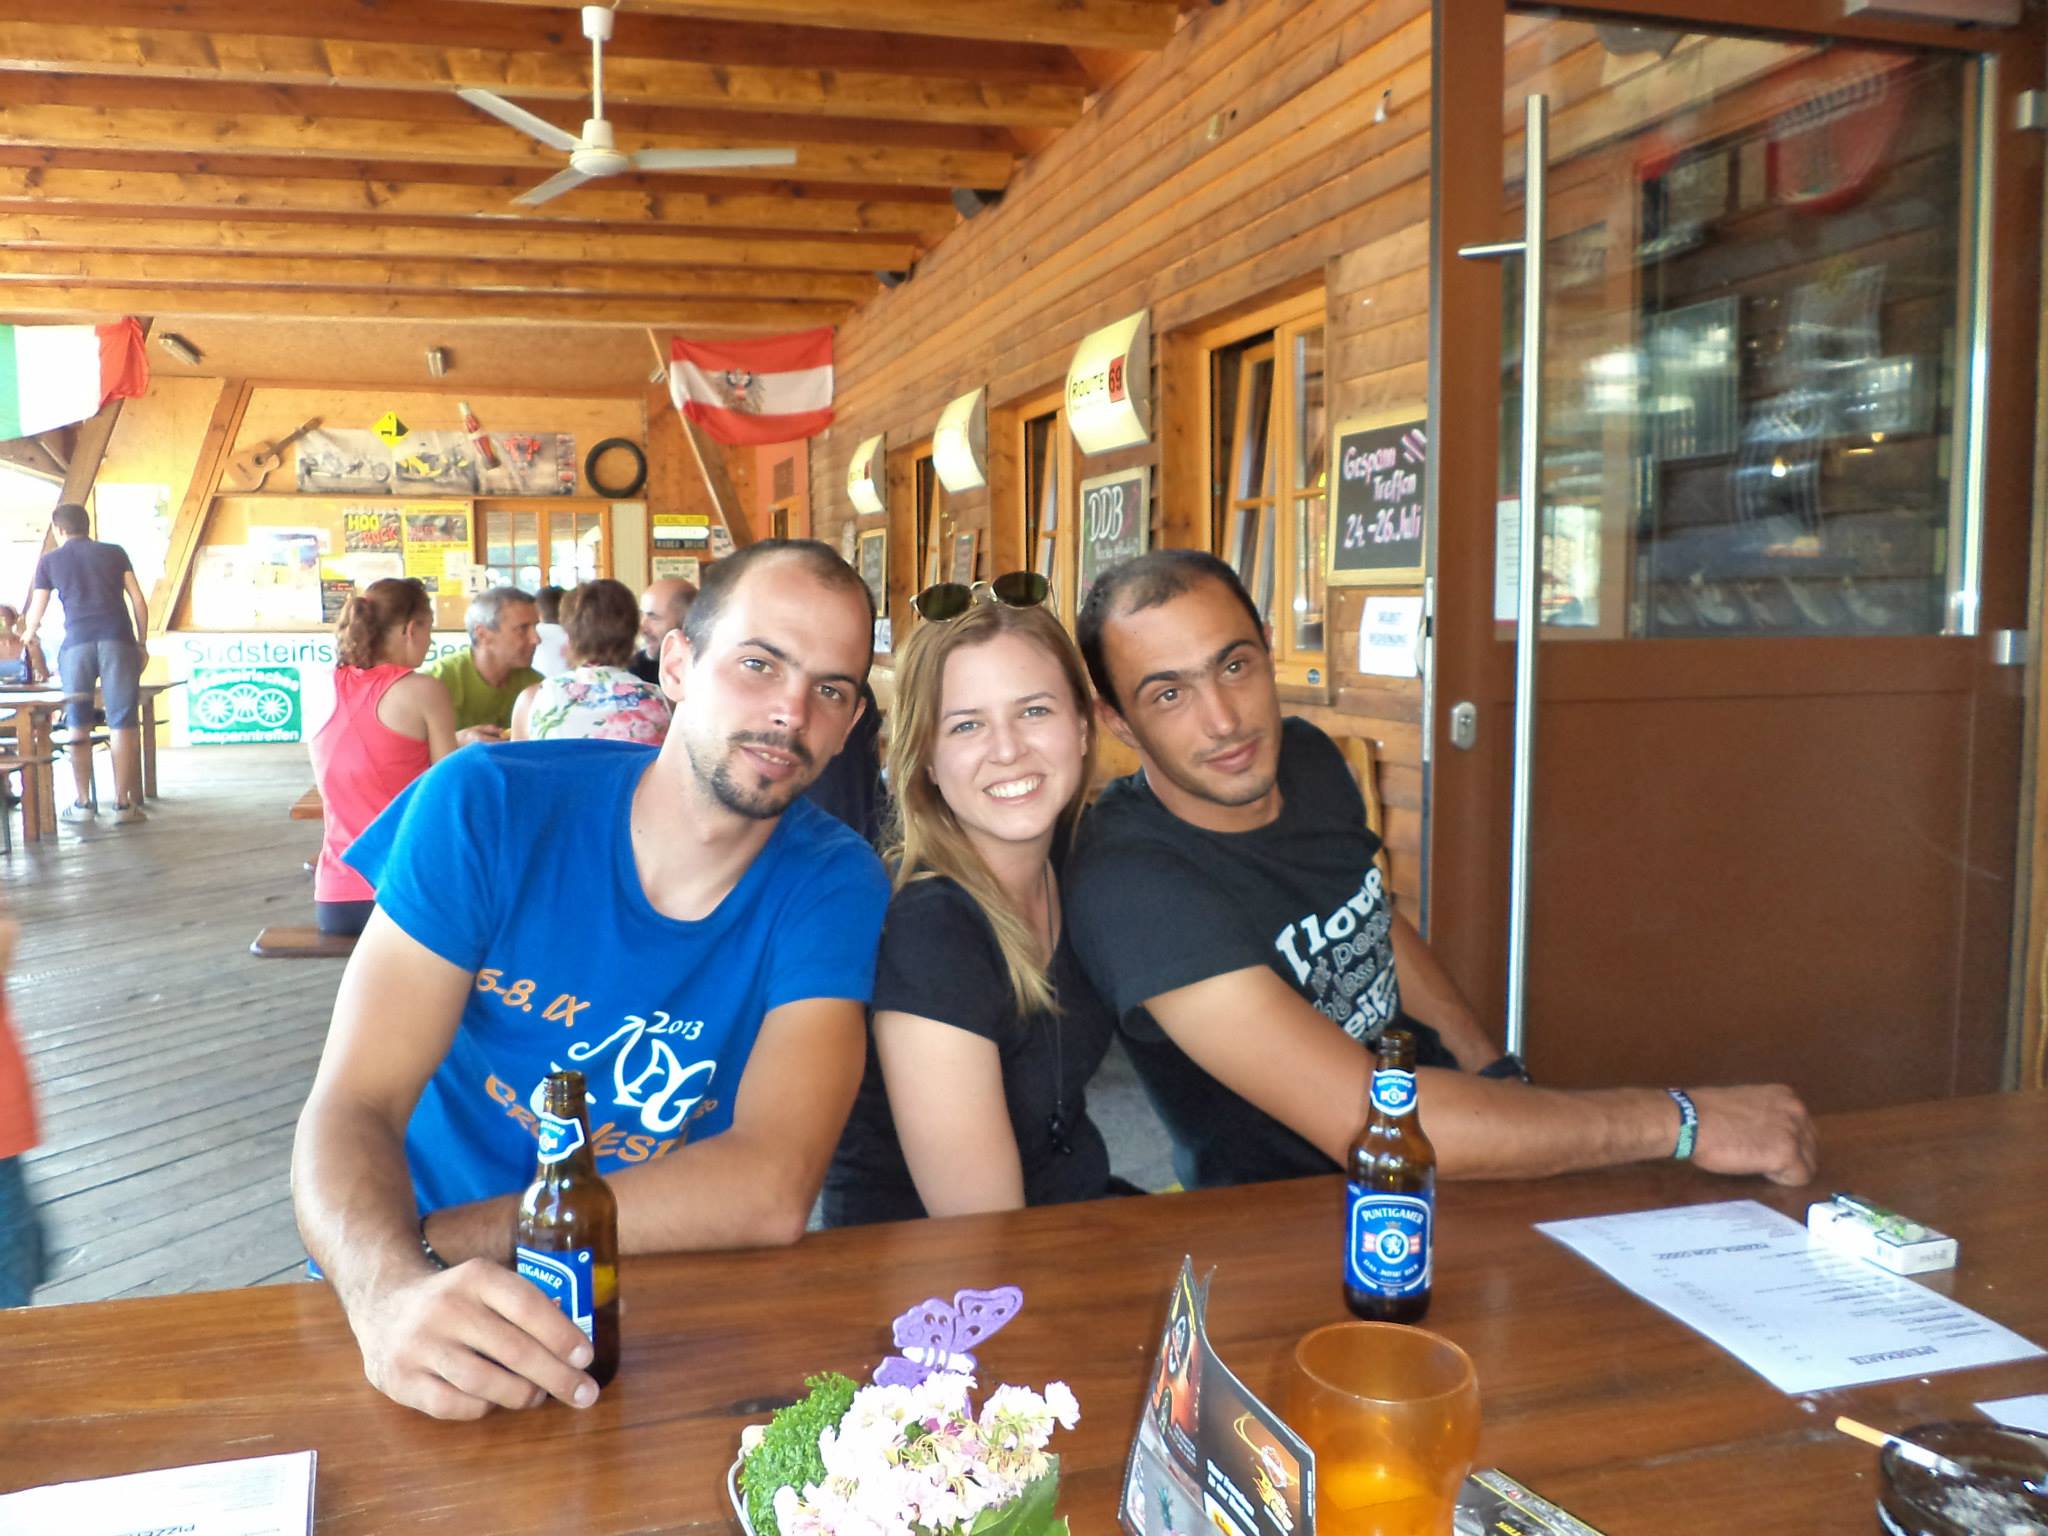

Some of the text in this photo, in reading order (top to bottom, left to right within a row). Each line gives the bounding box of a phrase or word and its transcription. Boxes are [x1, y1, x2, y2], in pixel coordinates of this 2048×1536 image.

[1071, 366, 1122, 399] ROUTE 69
[1088, 485, 1124, 542] DDB
[1275, 923, 1312, 986] I
[1300, 867, 1382, 955] love
[541, 993, 591, 1027] IX
[645, 1011, 704, 1040] 2013
[1361, 1207, 1424, 1225] PUNTIGAMER
